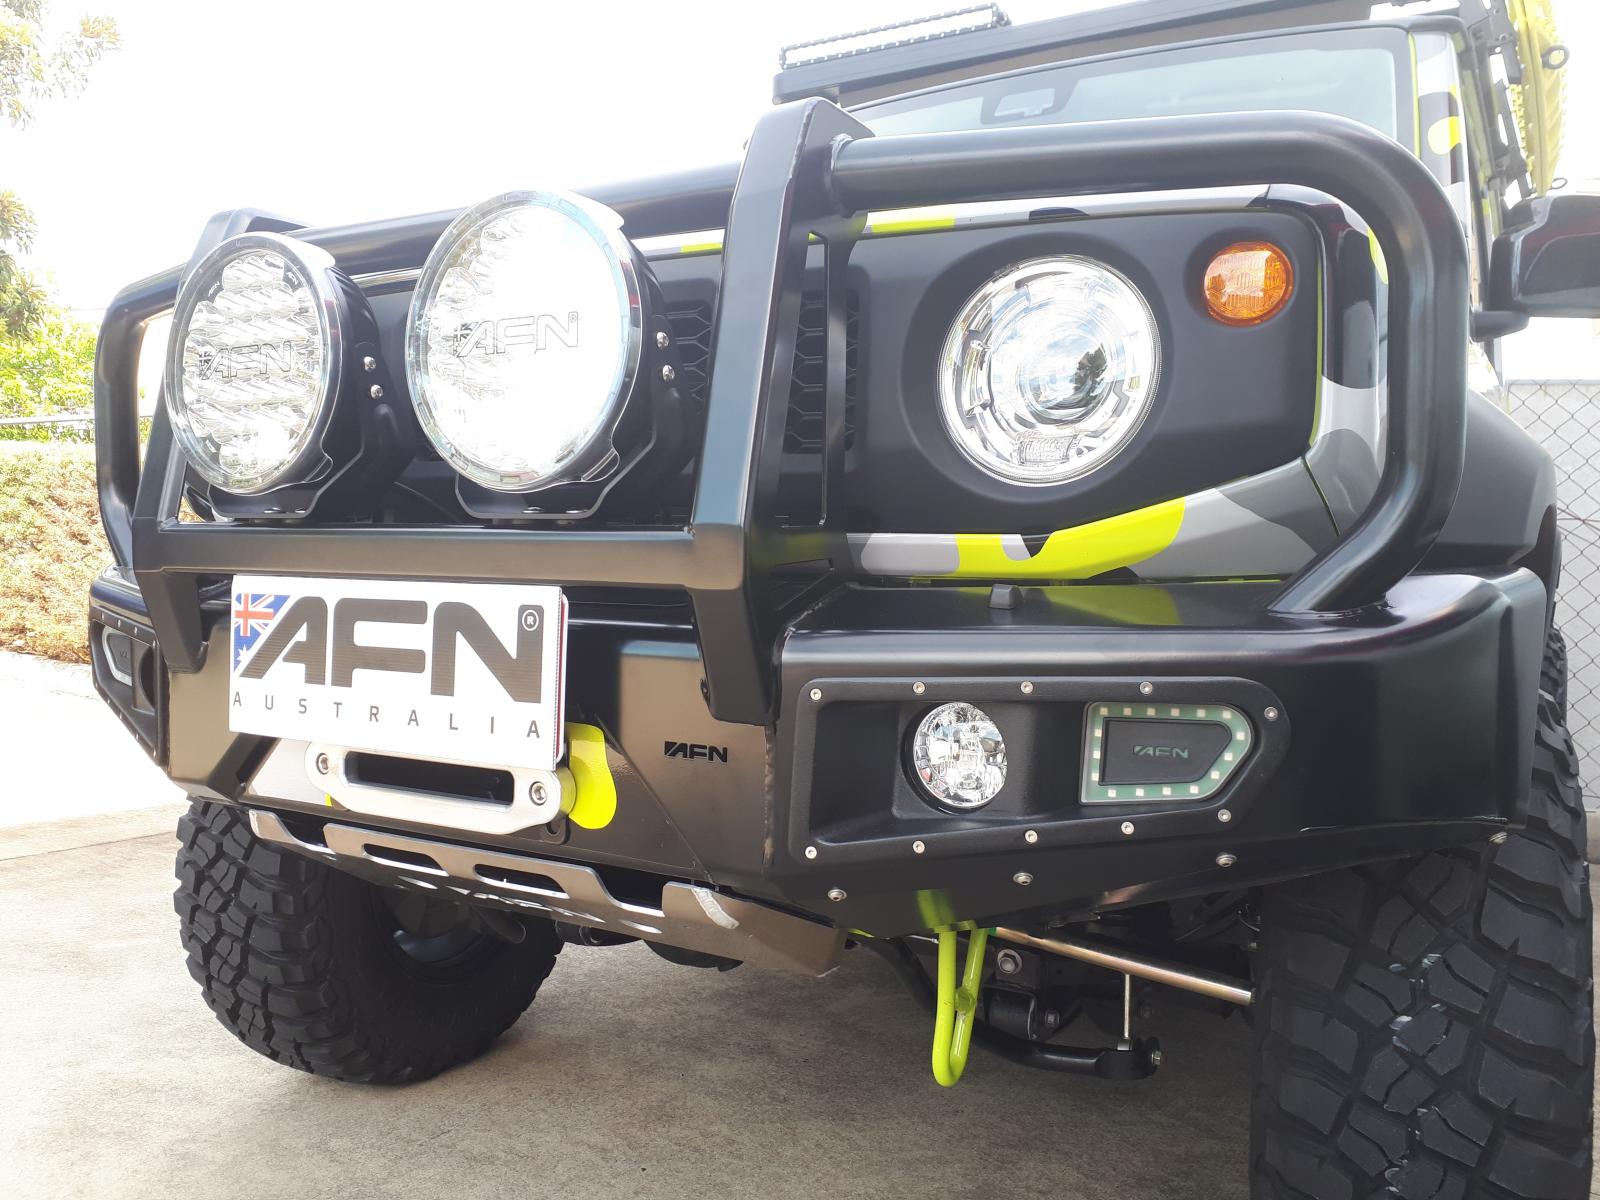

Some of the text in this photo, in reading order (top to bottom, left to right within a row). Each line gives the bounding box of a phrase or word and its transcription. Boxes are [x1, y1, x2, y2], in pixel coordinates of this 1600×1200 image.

[232, 690, 541, 739] AUSTRALIA
[666, 741, 728, 763] AFN
[1136, 746, 1189, 759] AFN
